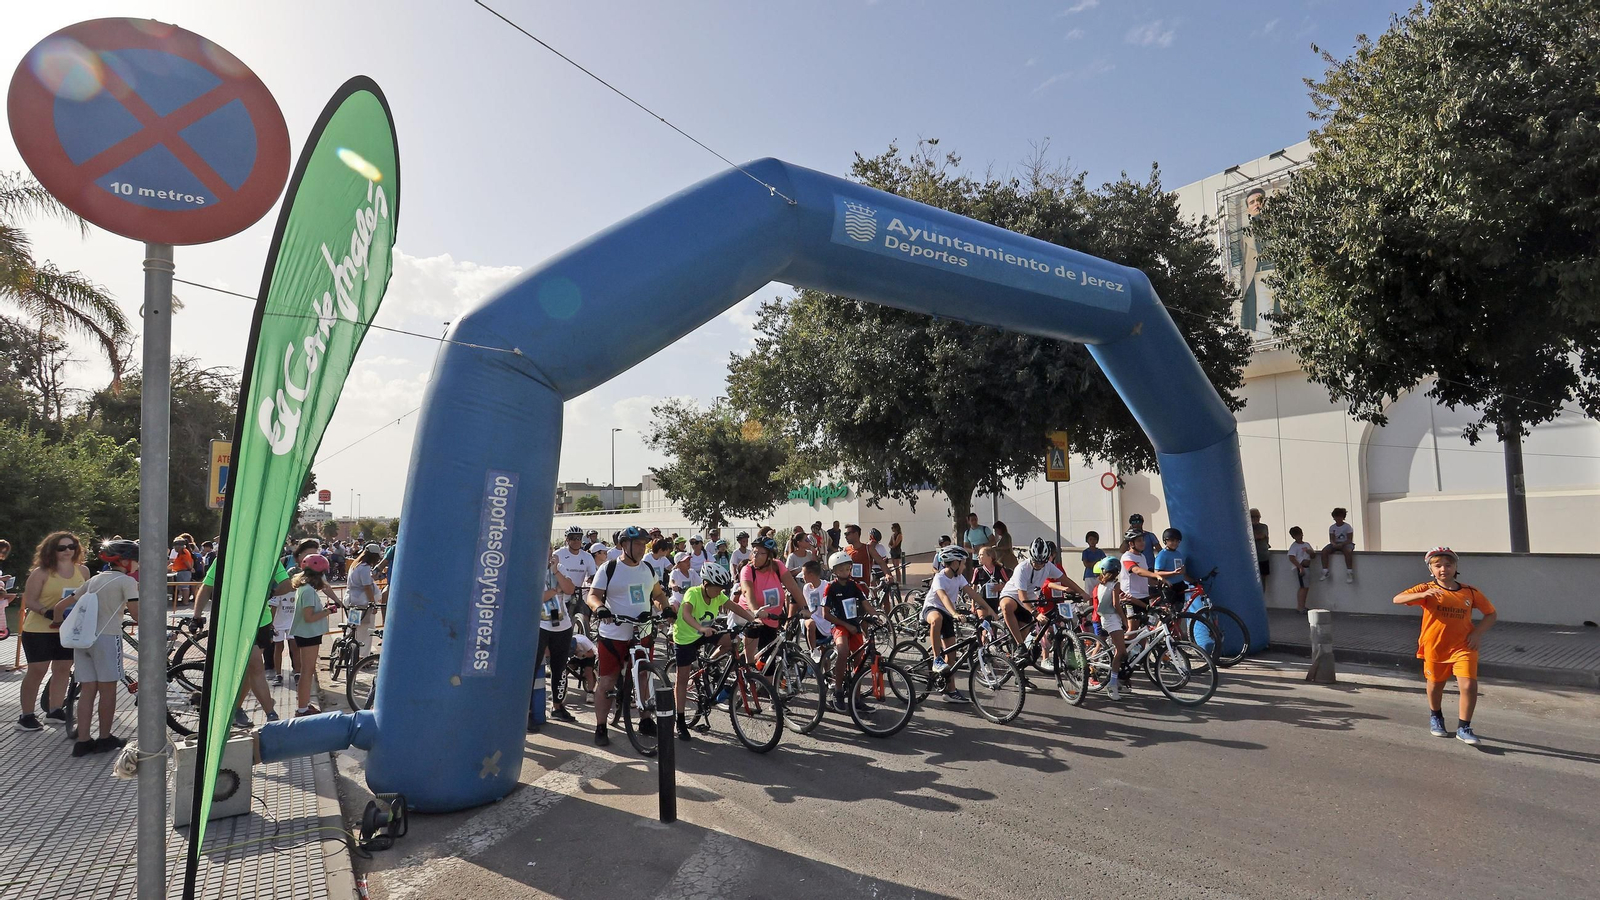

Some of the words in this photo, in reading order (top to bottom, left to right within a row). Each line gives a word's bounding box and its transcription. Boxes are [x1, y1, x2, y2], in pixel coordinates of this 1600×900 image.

[110, 181, 133, 195] 10
[138, 187, 205, 205] metros
[884, 234, 968, 268] Deportes
[886, 217, 1050, 274] Ayuntamiento
[1054, 265, 1077, 281] de
[1080, 270, 1125, 293] Jerez
[258, 388, 302, 456] El
[284, 291, 337, 402] Corte
[320, 178, 388, 323] Inglés
[473, 475, 514, 670] deportes@aytojerez.es
